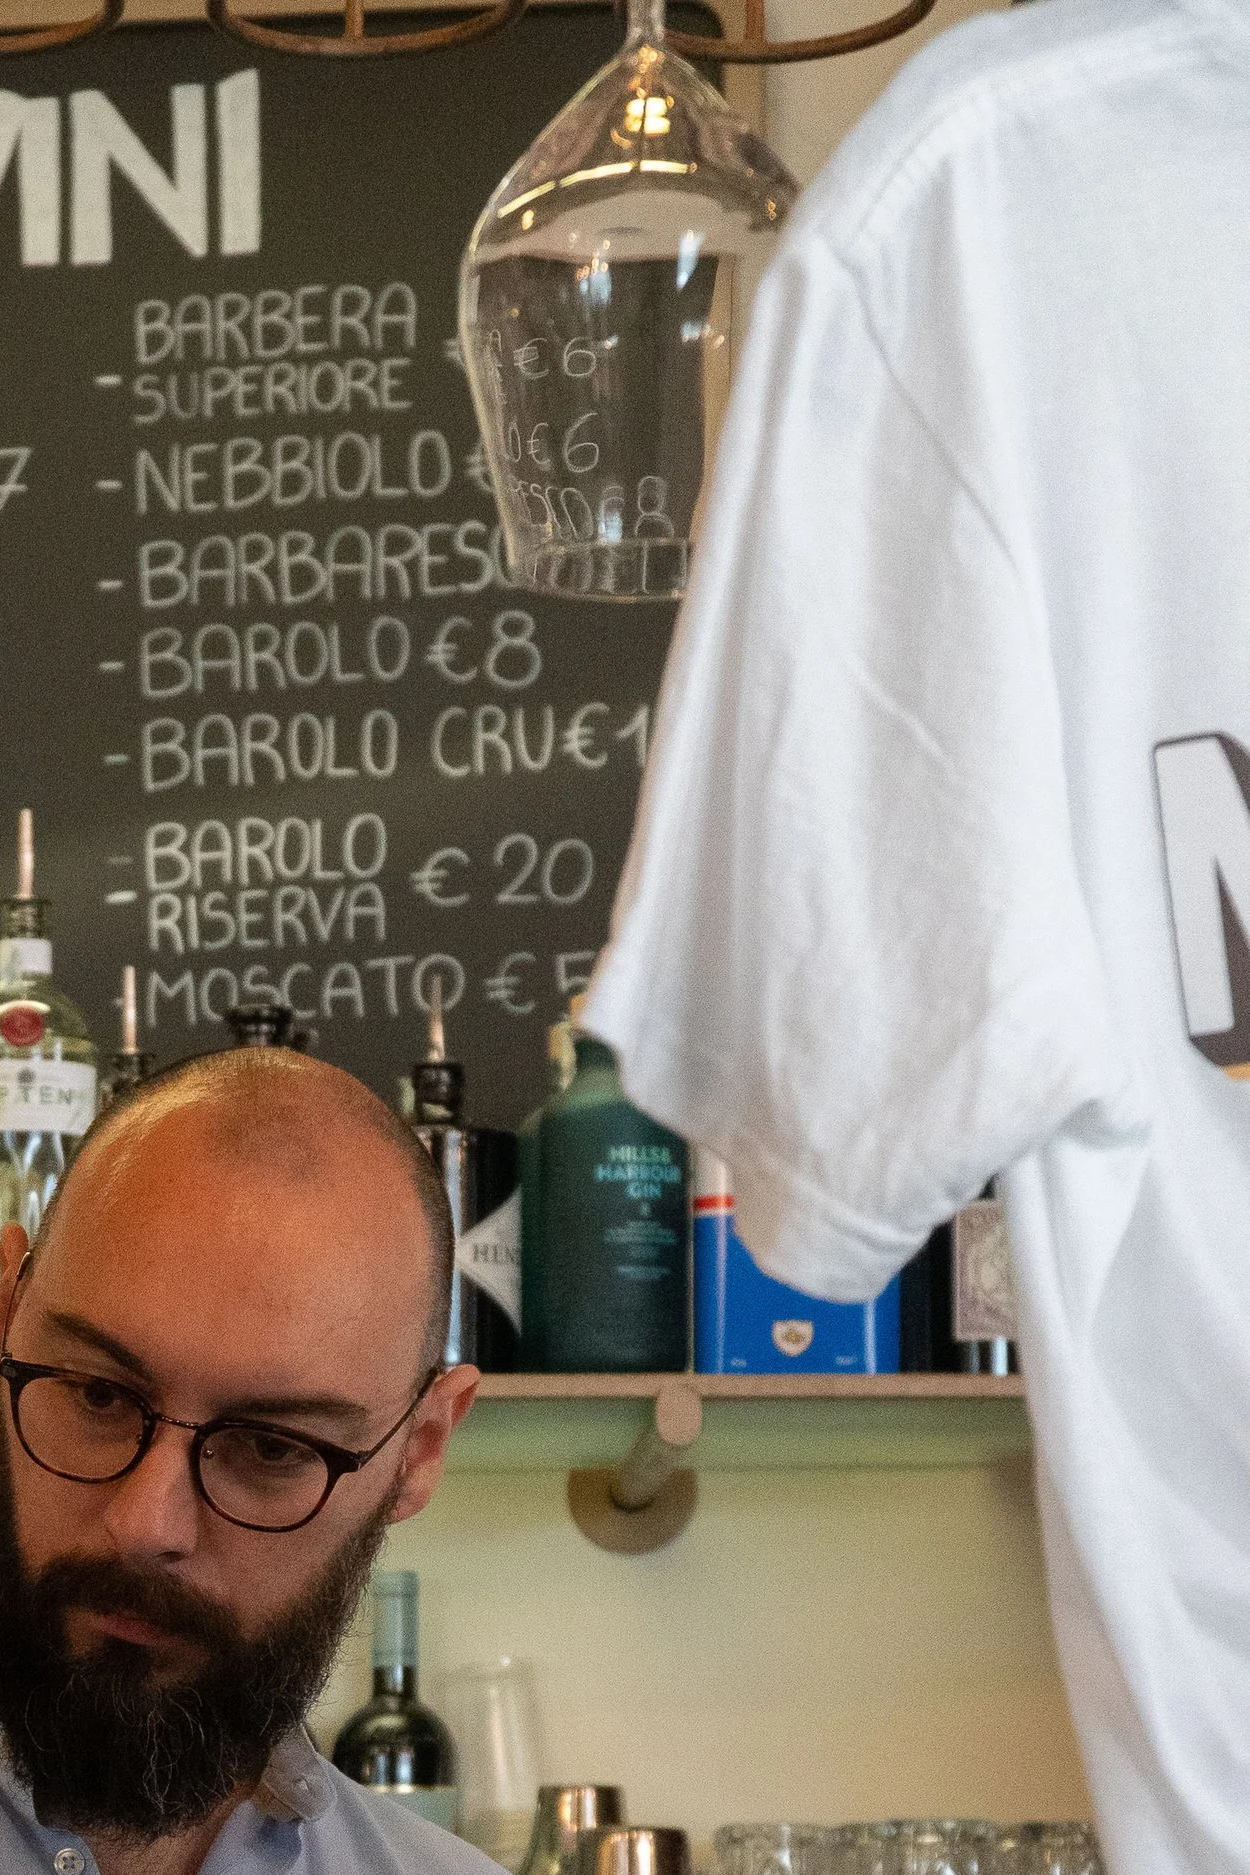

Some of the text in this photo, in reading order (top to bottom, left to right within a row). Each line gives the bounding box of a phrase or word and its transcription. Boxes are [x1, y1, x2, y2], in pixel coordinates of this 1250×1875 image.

[135, 284, 417, 363] BARBERA
[133, 361, 411, 425] SUPERIORE
[135, 429, 451, 514] NEBBIOLO
[140, 615, 410, 699] BAROLO
[143, 709, 398, 791] BAROLO
[431, 705, 554, 777] CRU
[144, 812, 387, 893] BAROLO
[150, 886, 386, 953] RISERVA
[148, 954, 466, 1029] MOSCATO
